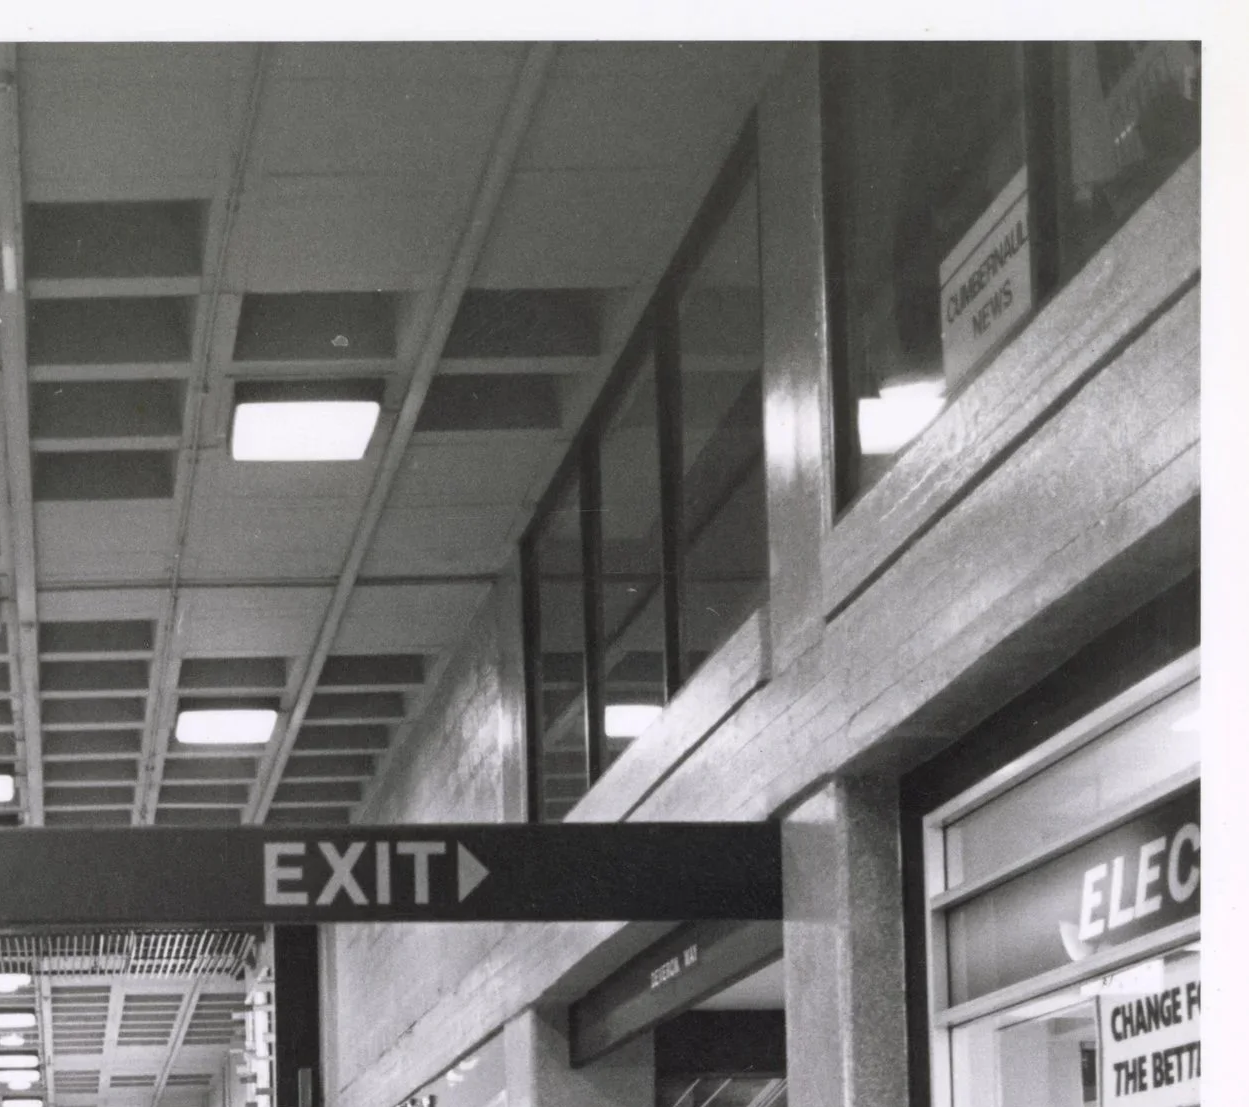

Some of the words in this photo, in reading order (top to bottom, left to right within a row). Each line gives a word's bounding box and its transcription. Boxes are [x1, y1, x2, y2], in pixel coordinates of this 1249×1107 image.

[947, 220, 1030, 323] CUMBERNAUL
[972, 278, 1013, 338] NEWS
[264, 841, 446, 905] EXIT
[682, 943, 697, 968] WAY
[1110, 986, 1182, 1042] CHANGE
[1186, 981, 1200, 1021] F
[1113, 1055, 1148, 1097] THE
